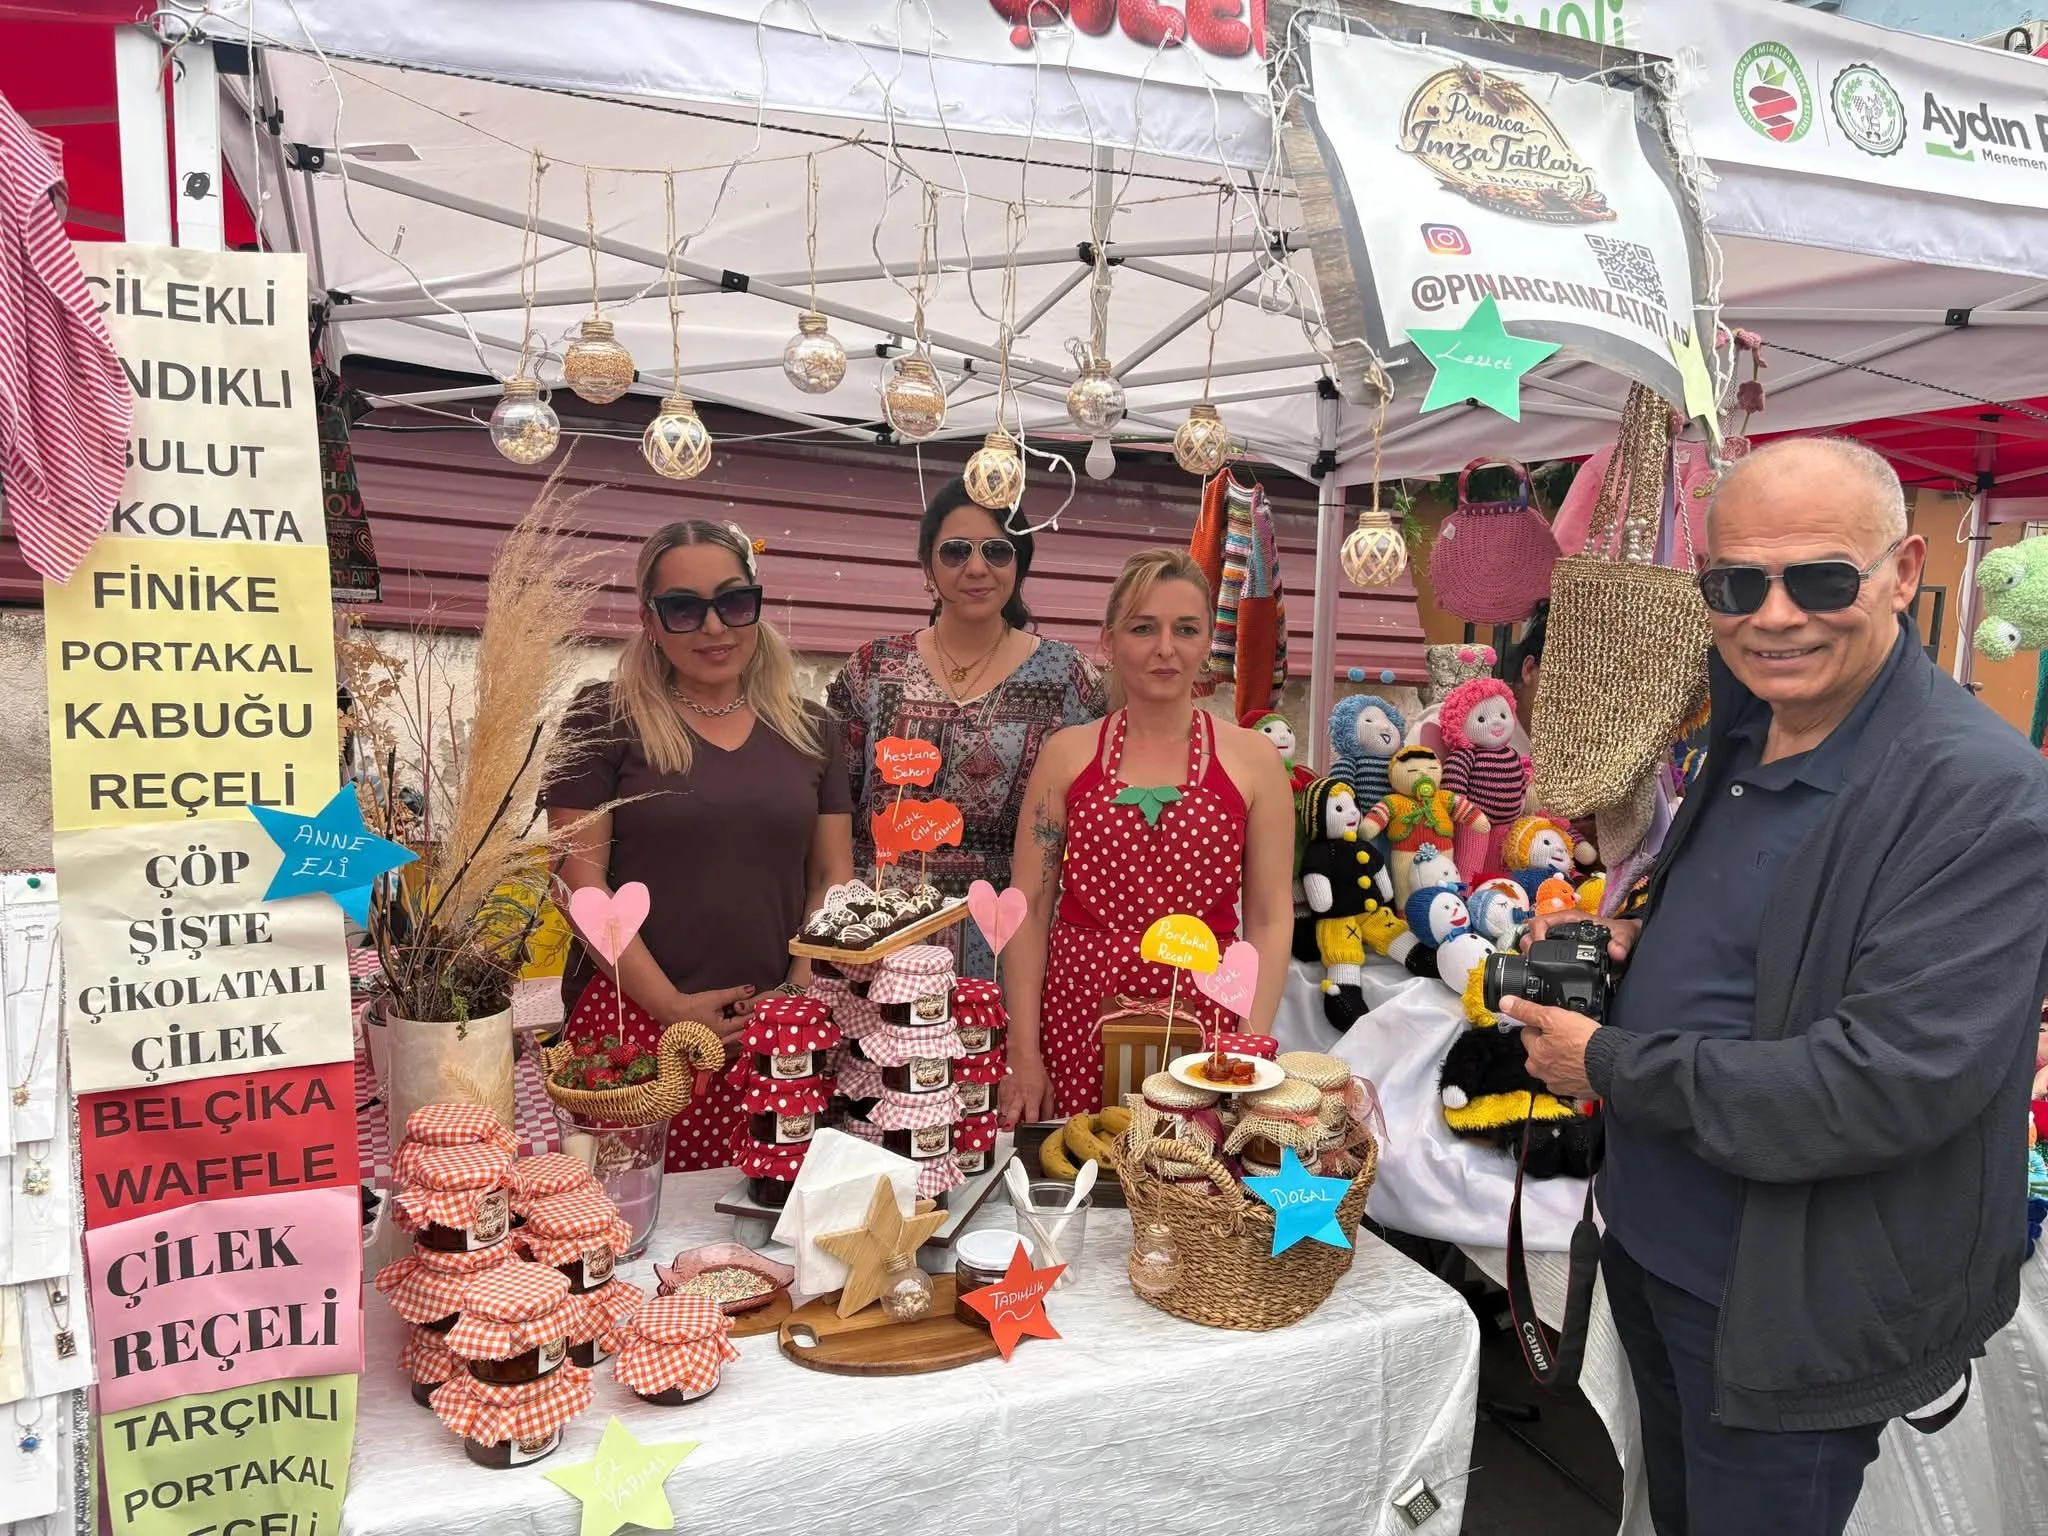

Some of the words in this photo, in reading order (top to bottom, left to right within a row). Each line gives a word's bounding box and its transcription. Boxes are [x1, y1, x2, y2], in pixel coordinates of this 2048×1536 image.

[1923, 91, 2032, 149] Aydın
[1981, 148, 2047, 170] Menemen
[104, 501, 304, 543] KOLATA
[93, 564, 280, 613] FİNİKE
[61, 640, 313, 674] PORTAKAL
[65, 693, 313, 740] KABUĞU
[883, 746, 938, 765] Kestane
[89, 763, 295, 817] REÇELİ
[293, 824, 374, 851] ANNE
[145, 844, 250, 899] ÇÖP
[292, 856, 349, 878] ELİ
[128, 907, 273, 966] ŞİŞTE
[78, 963, 329, 1024] ÇİKOLATALI
[131, 1022, 288, 1083] ÇİLEK
[94, 1078, 336, 1138] BELÇİKA
[95, 1143, 338, 1209] WAFFLE
[106, 1224, 303, 1309] ÇİLEK
[111, 1288, 340, 1380] REÇELİ
[1523, 1321, 1549, 1371] Canon
[114, 1386, 338, 1452] TARÇINLI
[123, 1455, 335, 1524] PORTAKAL
